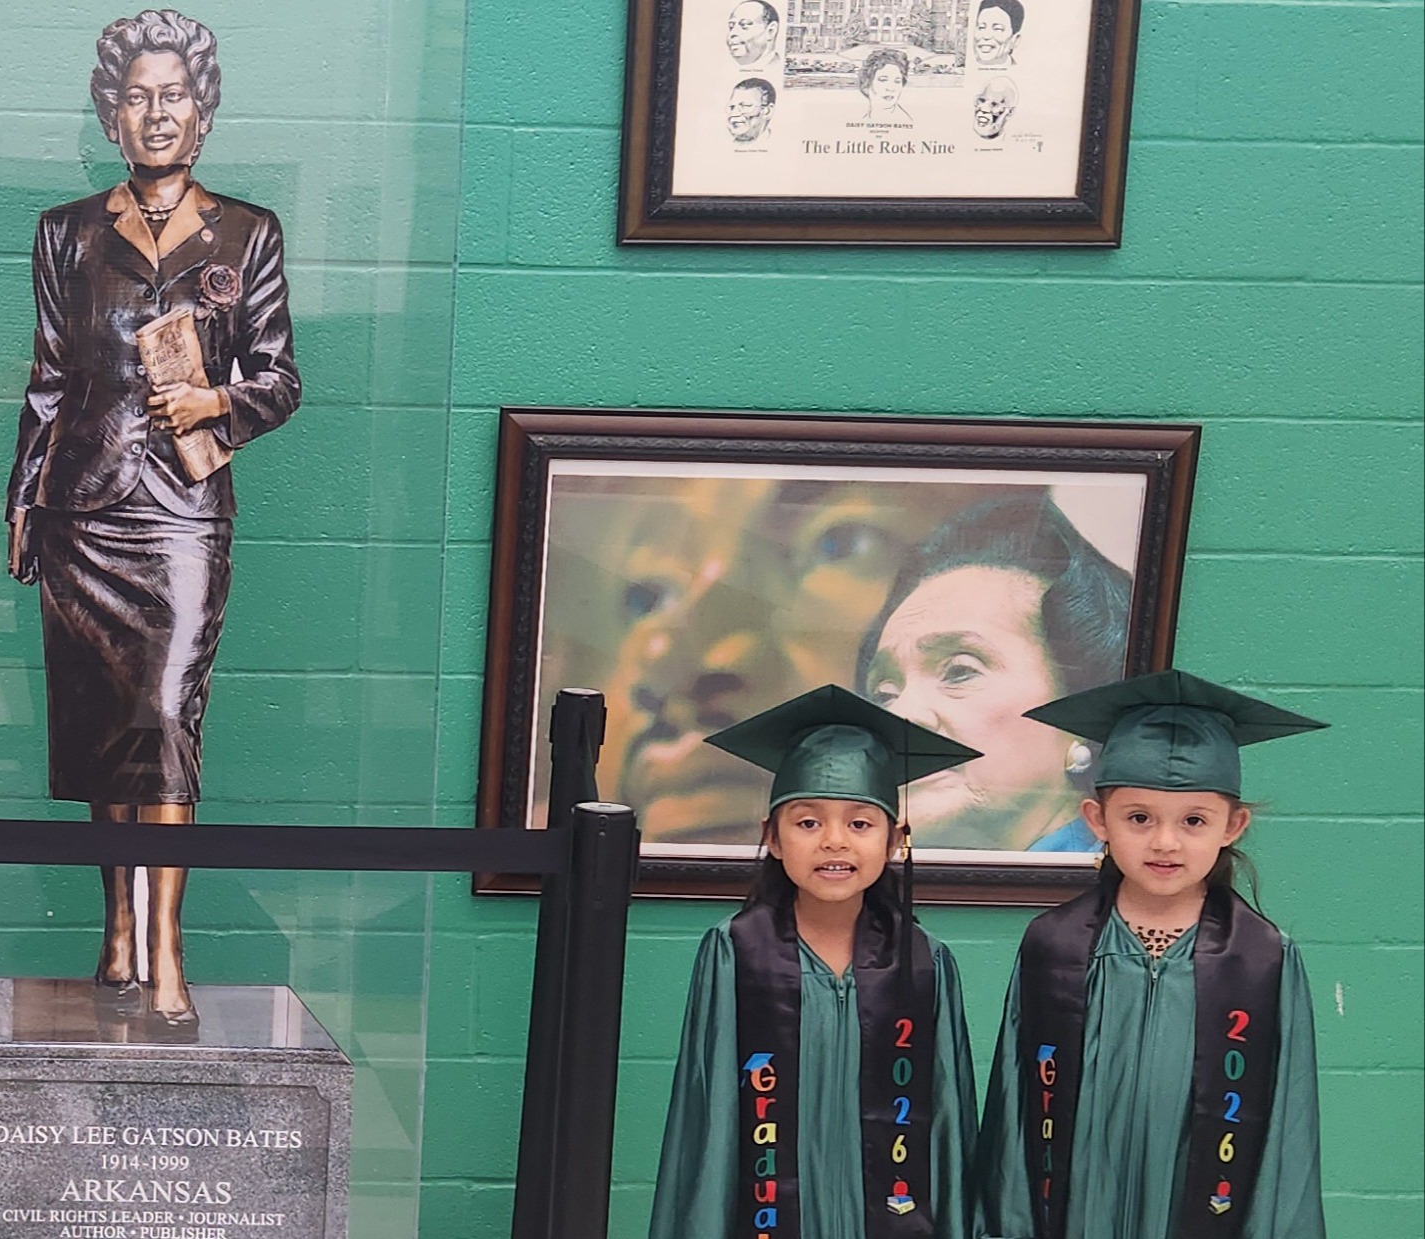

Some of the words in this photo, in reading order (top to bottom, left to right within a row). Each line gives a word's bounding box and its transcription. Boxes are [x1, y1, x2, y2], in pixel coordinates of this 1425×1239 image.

[802, 140, 831, 154] The
[835, 140, 875, 154] Little
[879, 140, 916, 154] Rock
[920, 140, 956, 155] Nine
[891, 1018, 914, 1164] 2026
[1218, 1009, 1250, 1163] 2026
[71, 1126, 116, 1145] LEE
[122, 1126, 221, 1148] GATSON
[226, 1129, 303, 1149] BATES
[750, 1064, 778, 1239] Gradua
[100, 1155, 190, 1172] 1914-1999
[59, 1178, 233, 1205] ARKANSAS
[2, 1209, 46, 1222] CIVIL
[49, 1209, 107, 1223] RIGHTS
[111, 1210, 176, 1224] LEADER
[187, 1211, 286, 1226] JOURNALIST
[59, 1225, 127, 1239] AUTHOR
[140, 1226, 227, 1239] PUBLISHER
